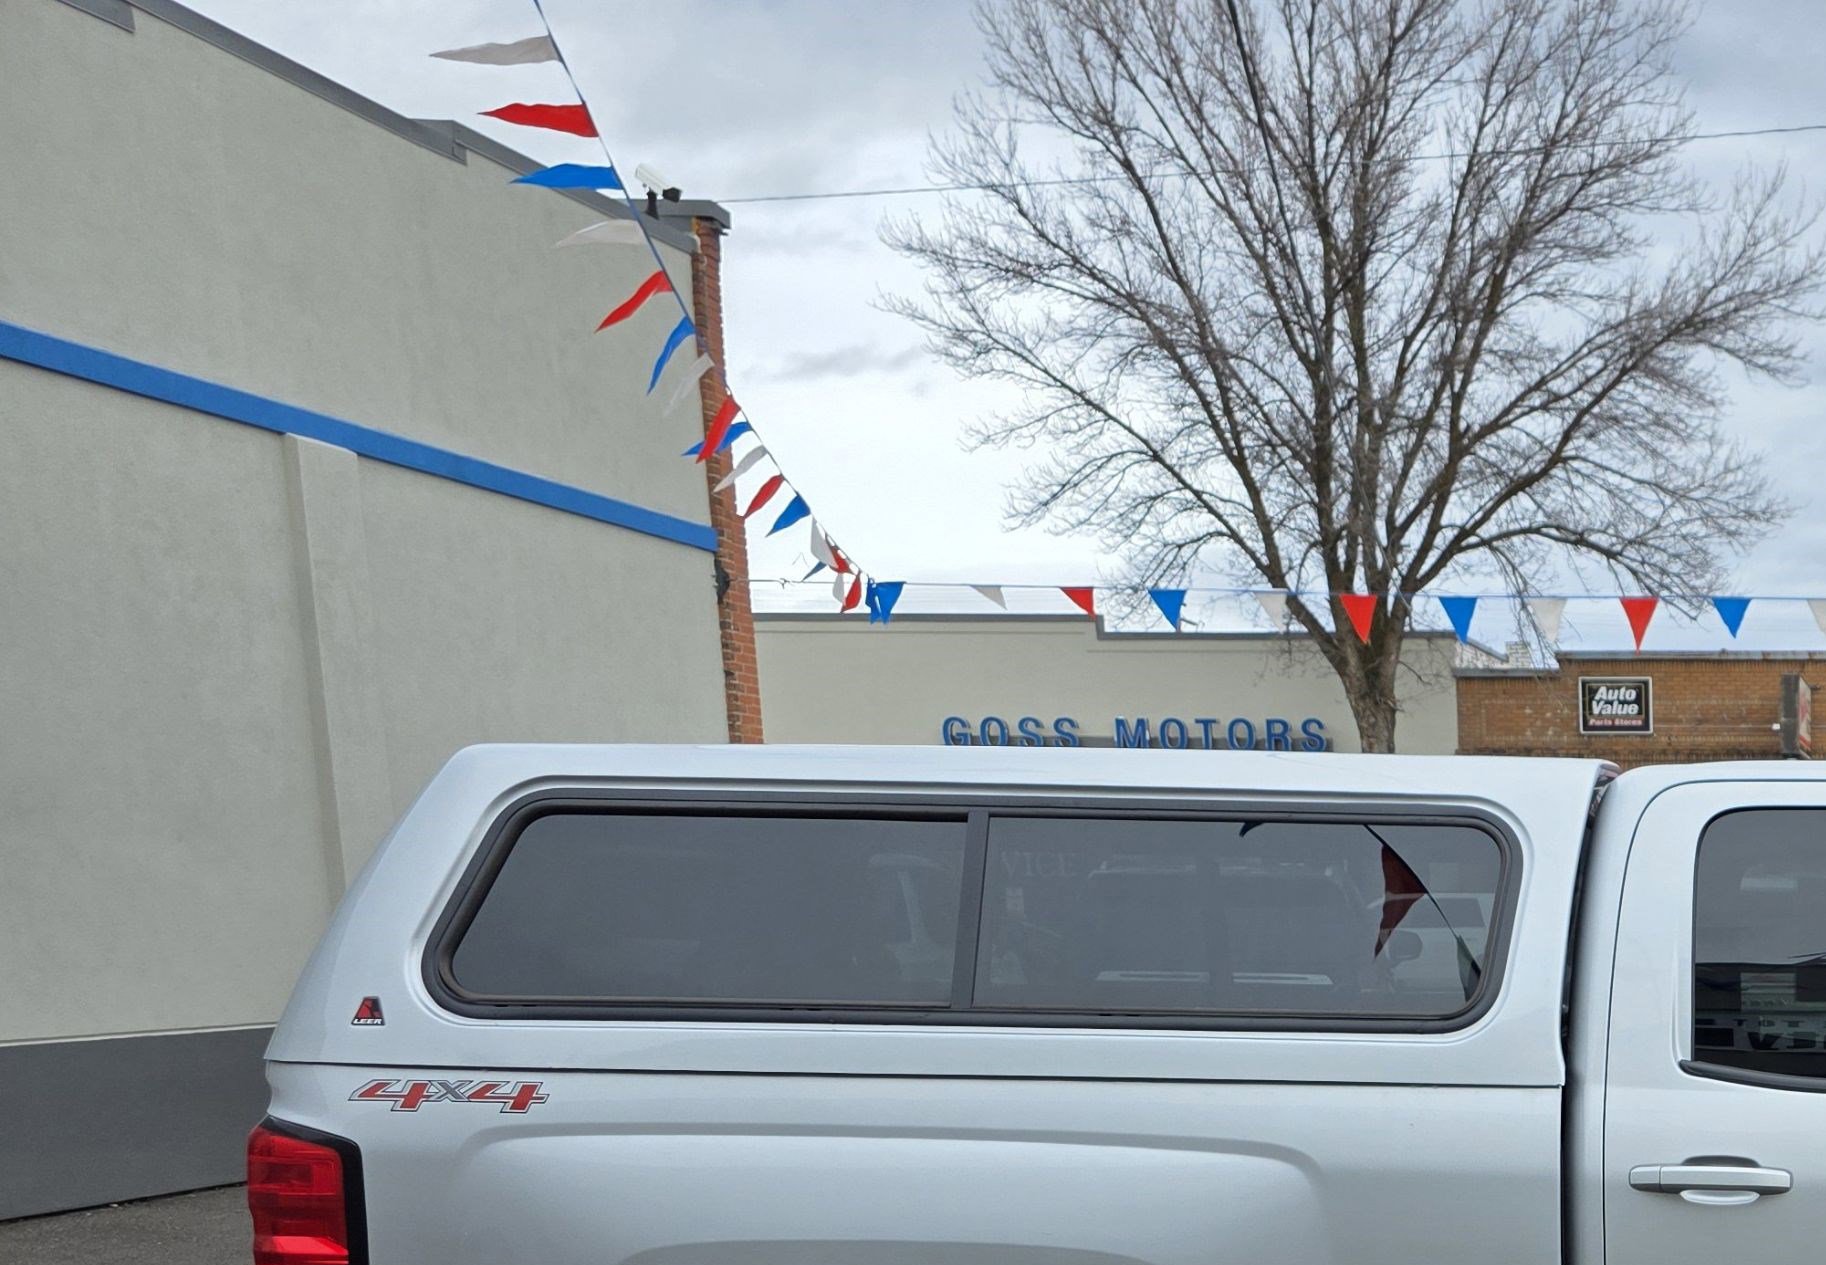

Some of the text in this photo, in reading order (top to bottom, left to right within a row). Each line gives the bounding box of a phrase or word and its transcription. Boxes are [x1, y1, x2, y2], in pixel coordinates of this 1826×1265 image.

[1594, 686, 1637, 701] Auto
[1591, 700, 1640, 715] Value
[941, 715, 1329, 752] GOSS MOTORS
